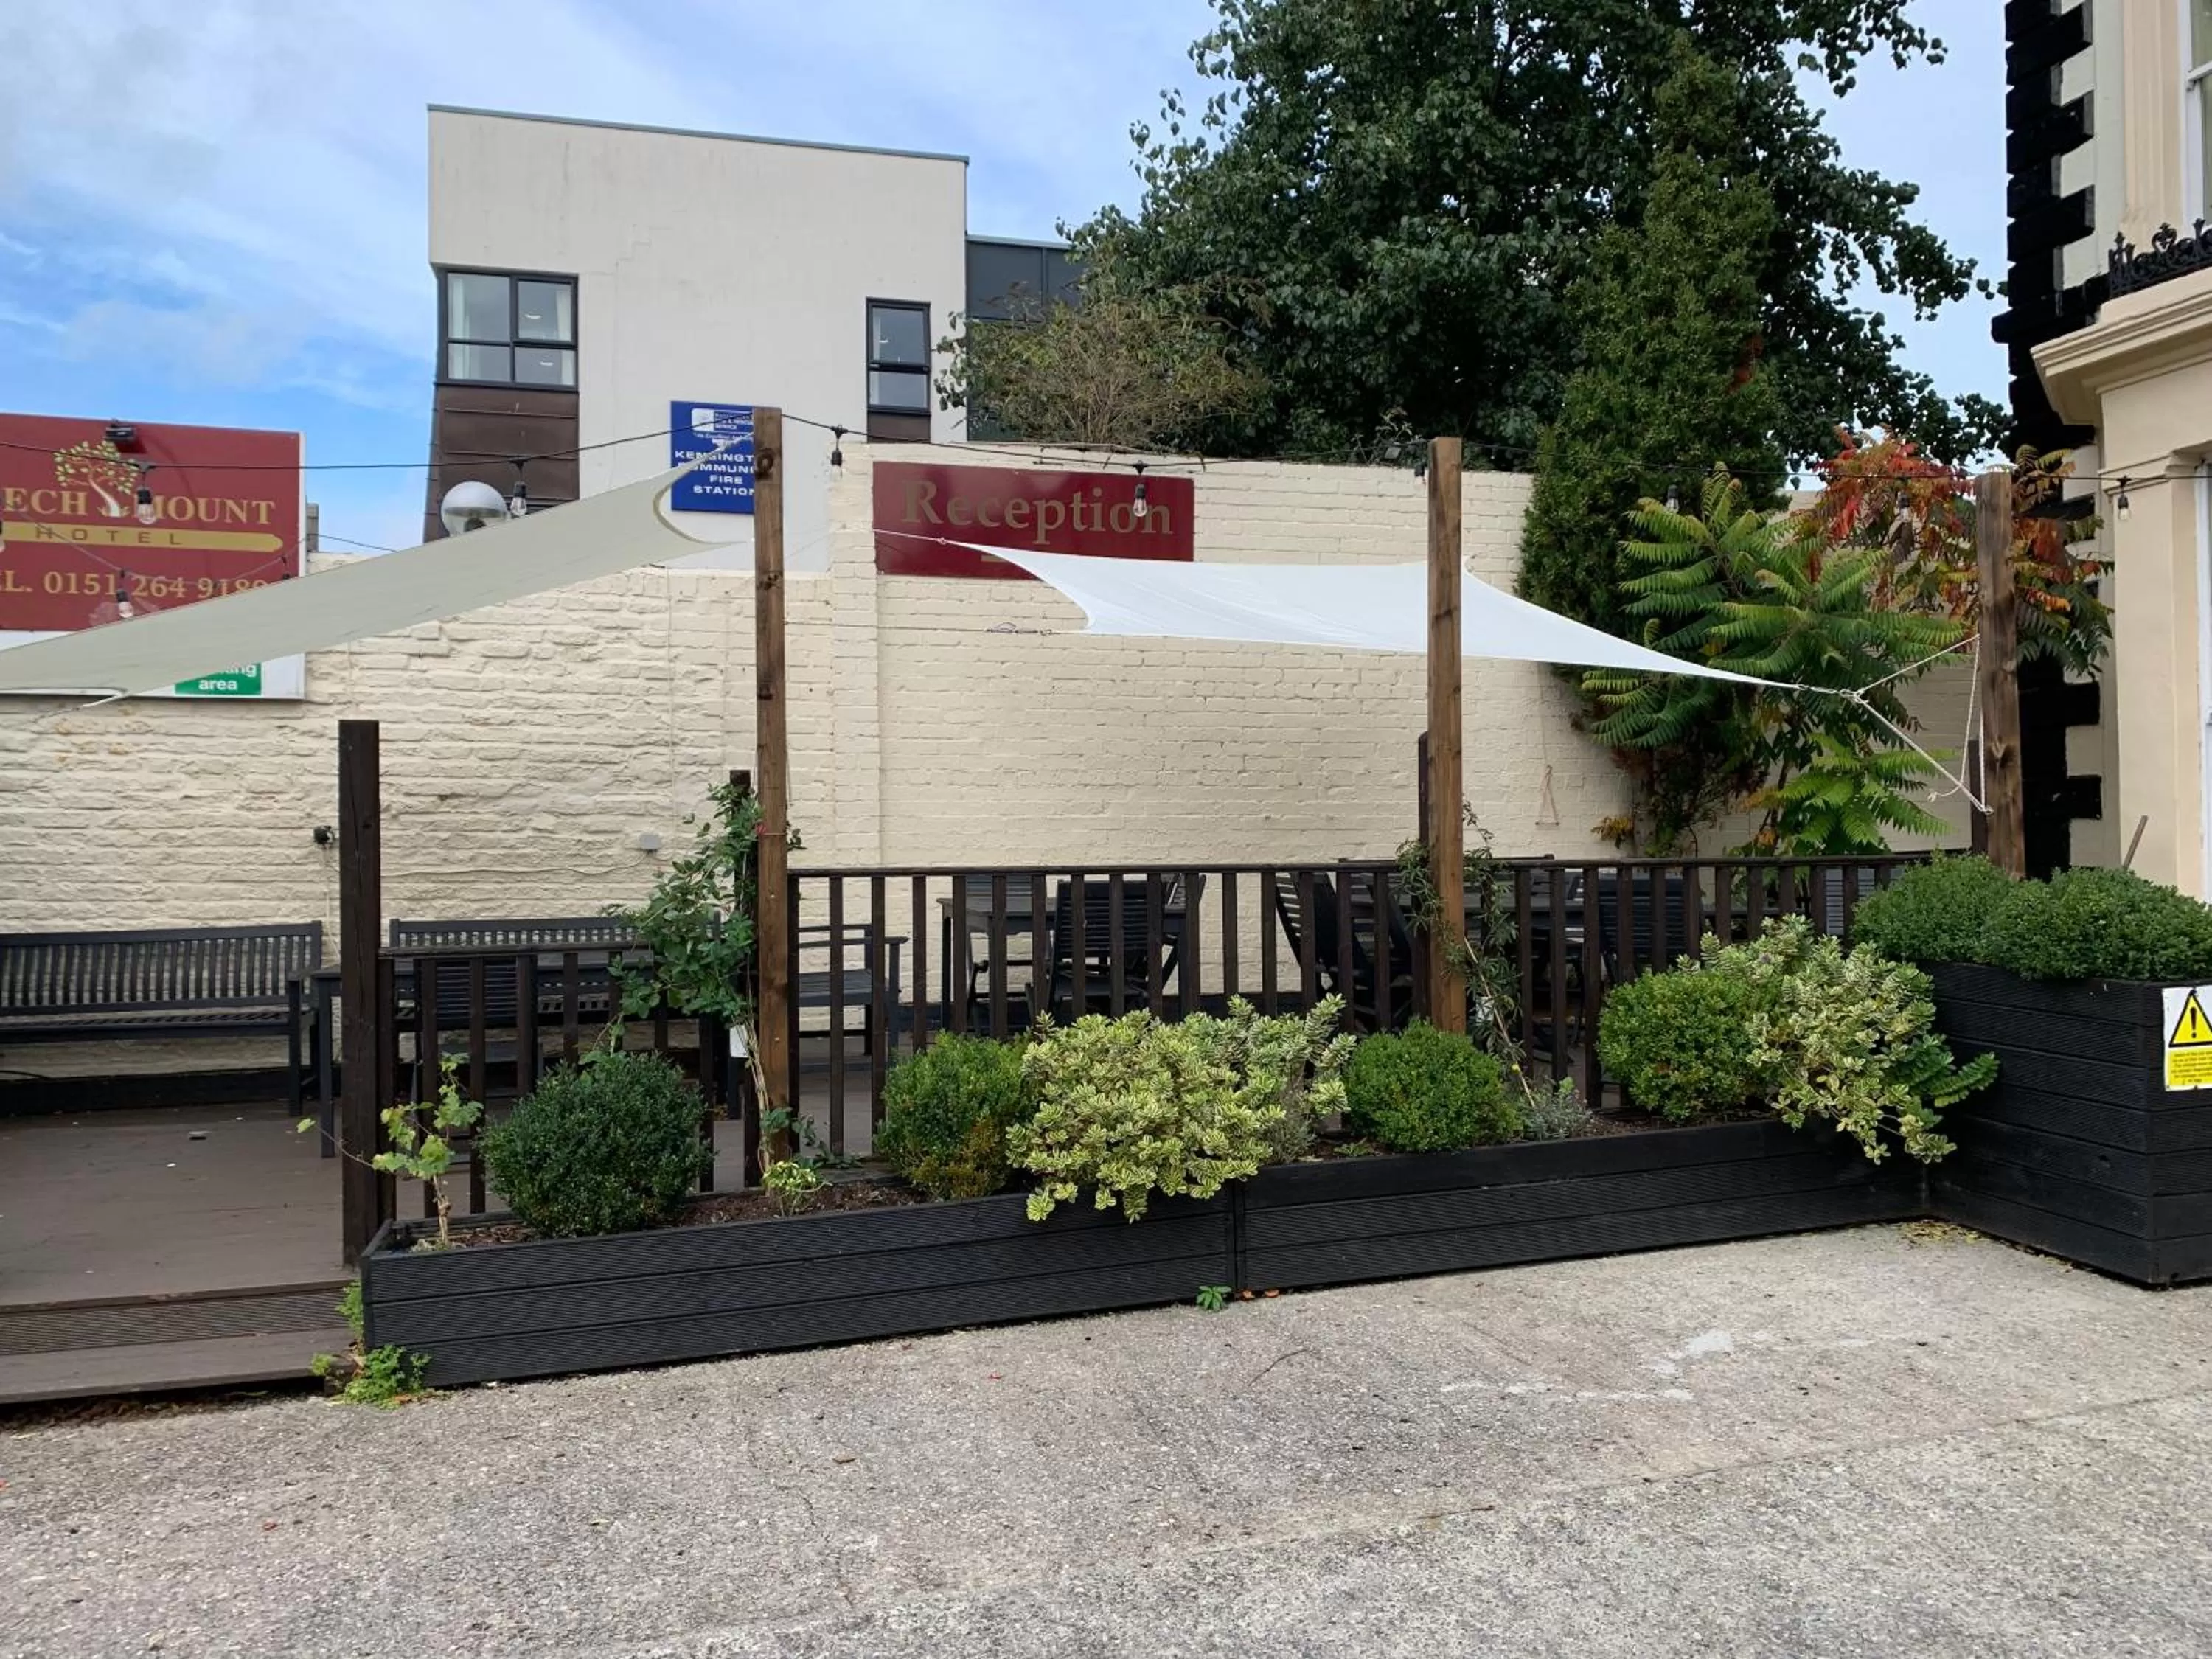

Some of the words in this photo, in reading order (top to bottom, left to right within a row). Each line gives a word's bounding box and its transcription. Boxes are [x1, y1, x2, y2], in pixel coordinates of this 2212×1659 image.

[709, 474, 743, 484] FIRE
[901, 480, 1174, 546] Reception
[36, 526, 182, 546] HOTEL
[0, 569, 33, 592] L.
[43, 571, 116, 595] 0151
[131, 574, 185, 599] 264
[198, 679, 238, 691] area
